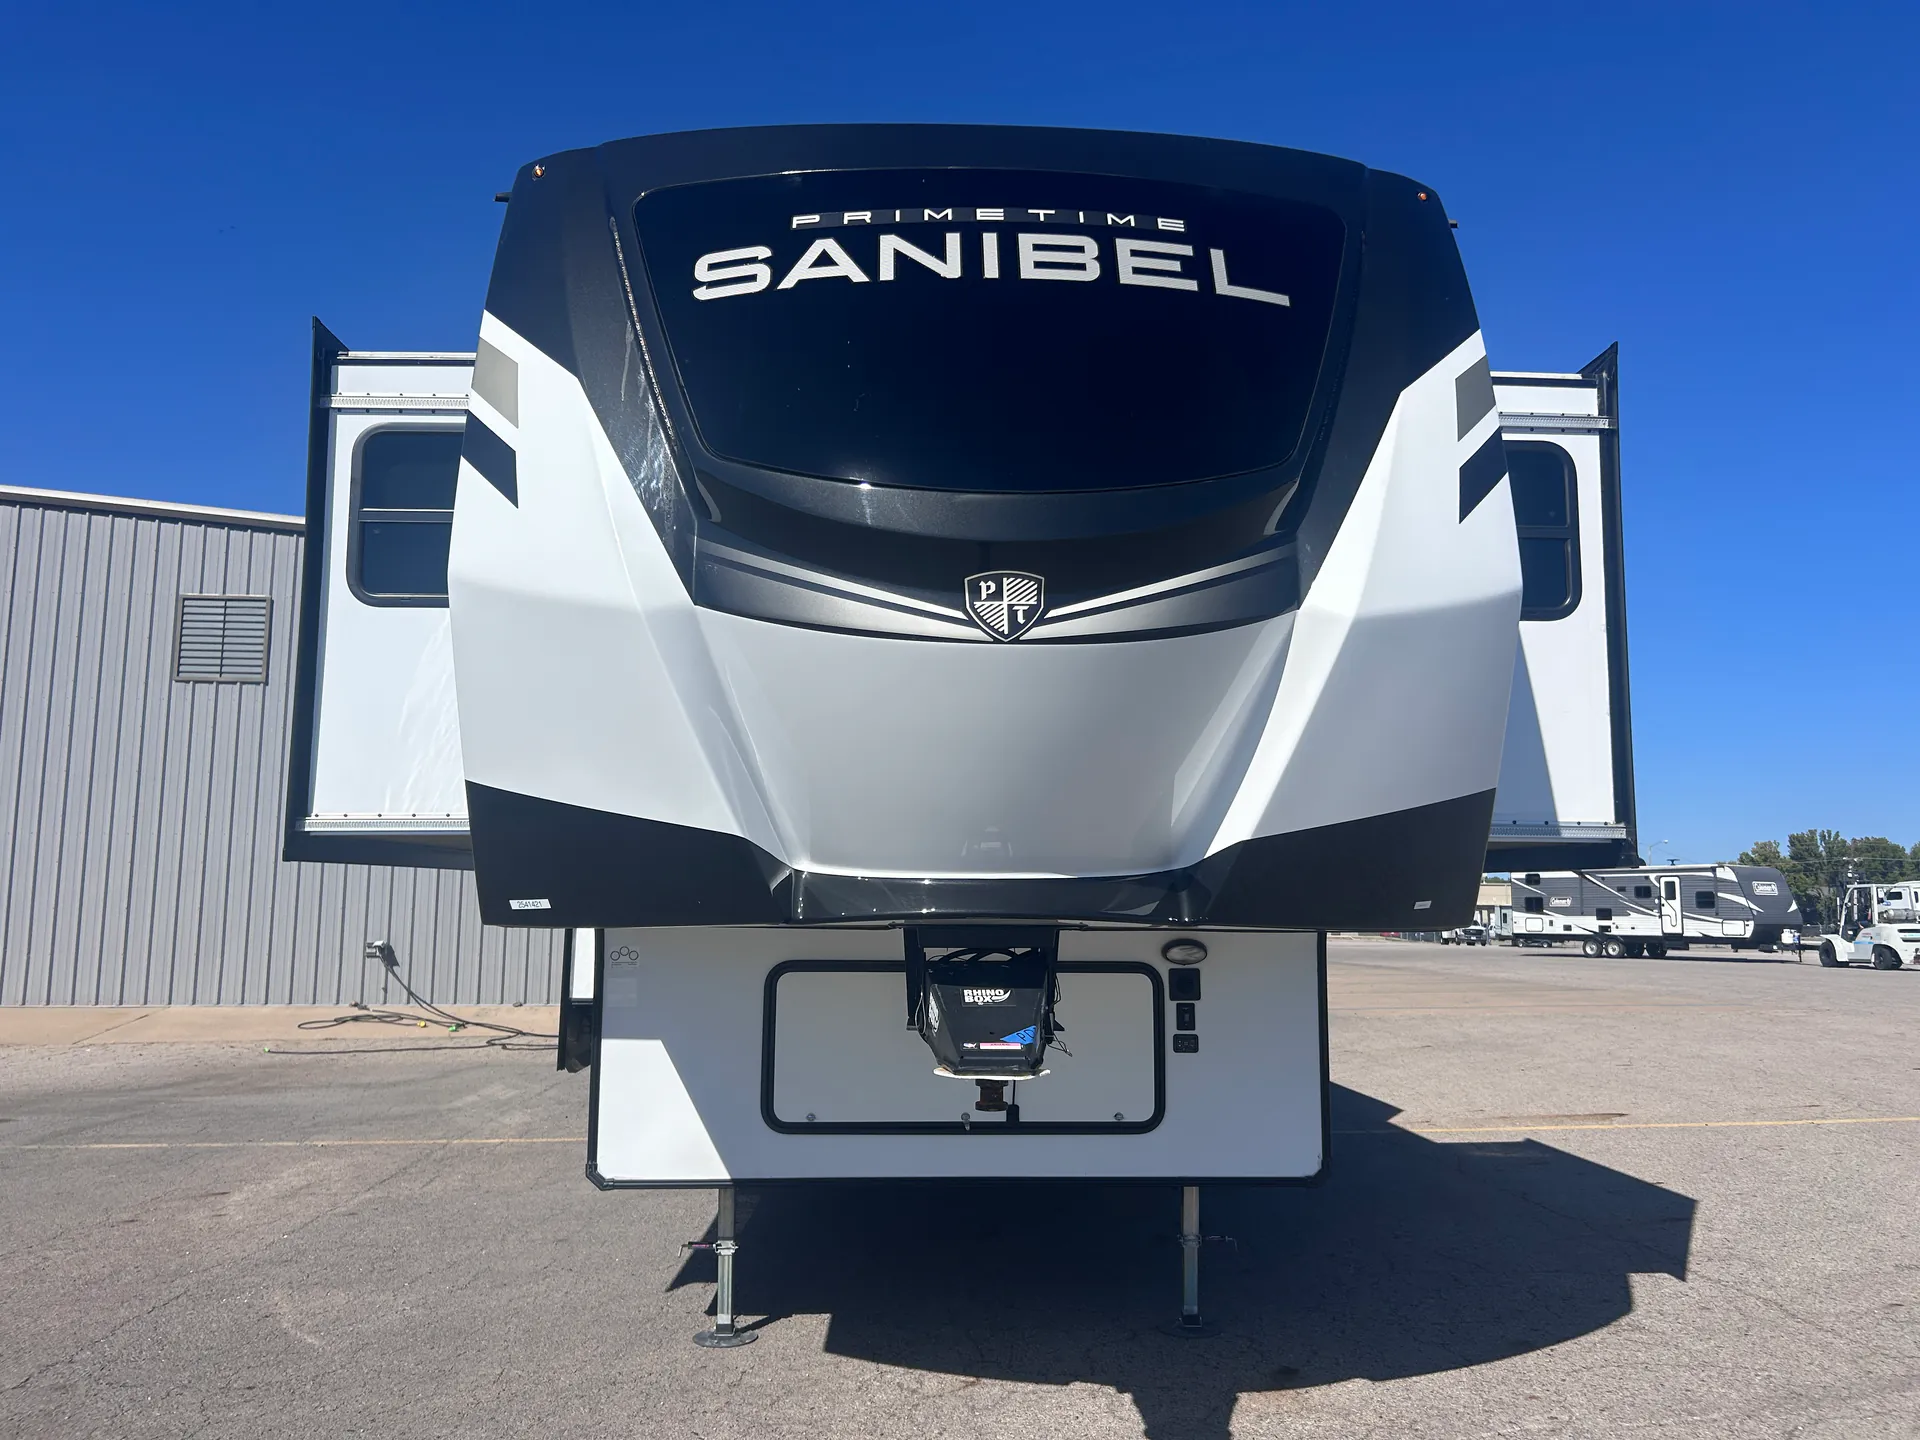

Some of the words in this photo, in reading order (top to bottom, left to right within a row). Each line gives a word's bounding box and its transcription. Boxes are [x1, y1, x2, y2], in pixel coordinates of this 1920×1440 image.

[791, 207, 1186, 232] PRIMETIME
[692, 232, 1291, 307] SANIBEL
[964, 995, 993, 1003] BOX
